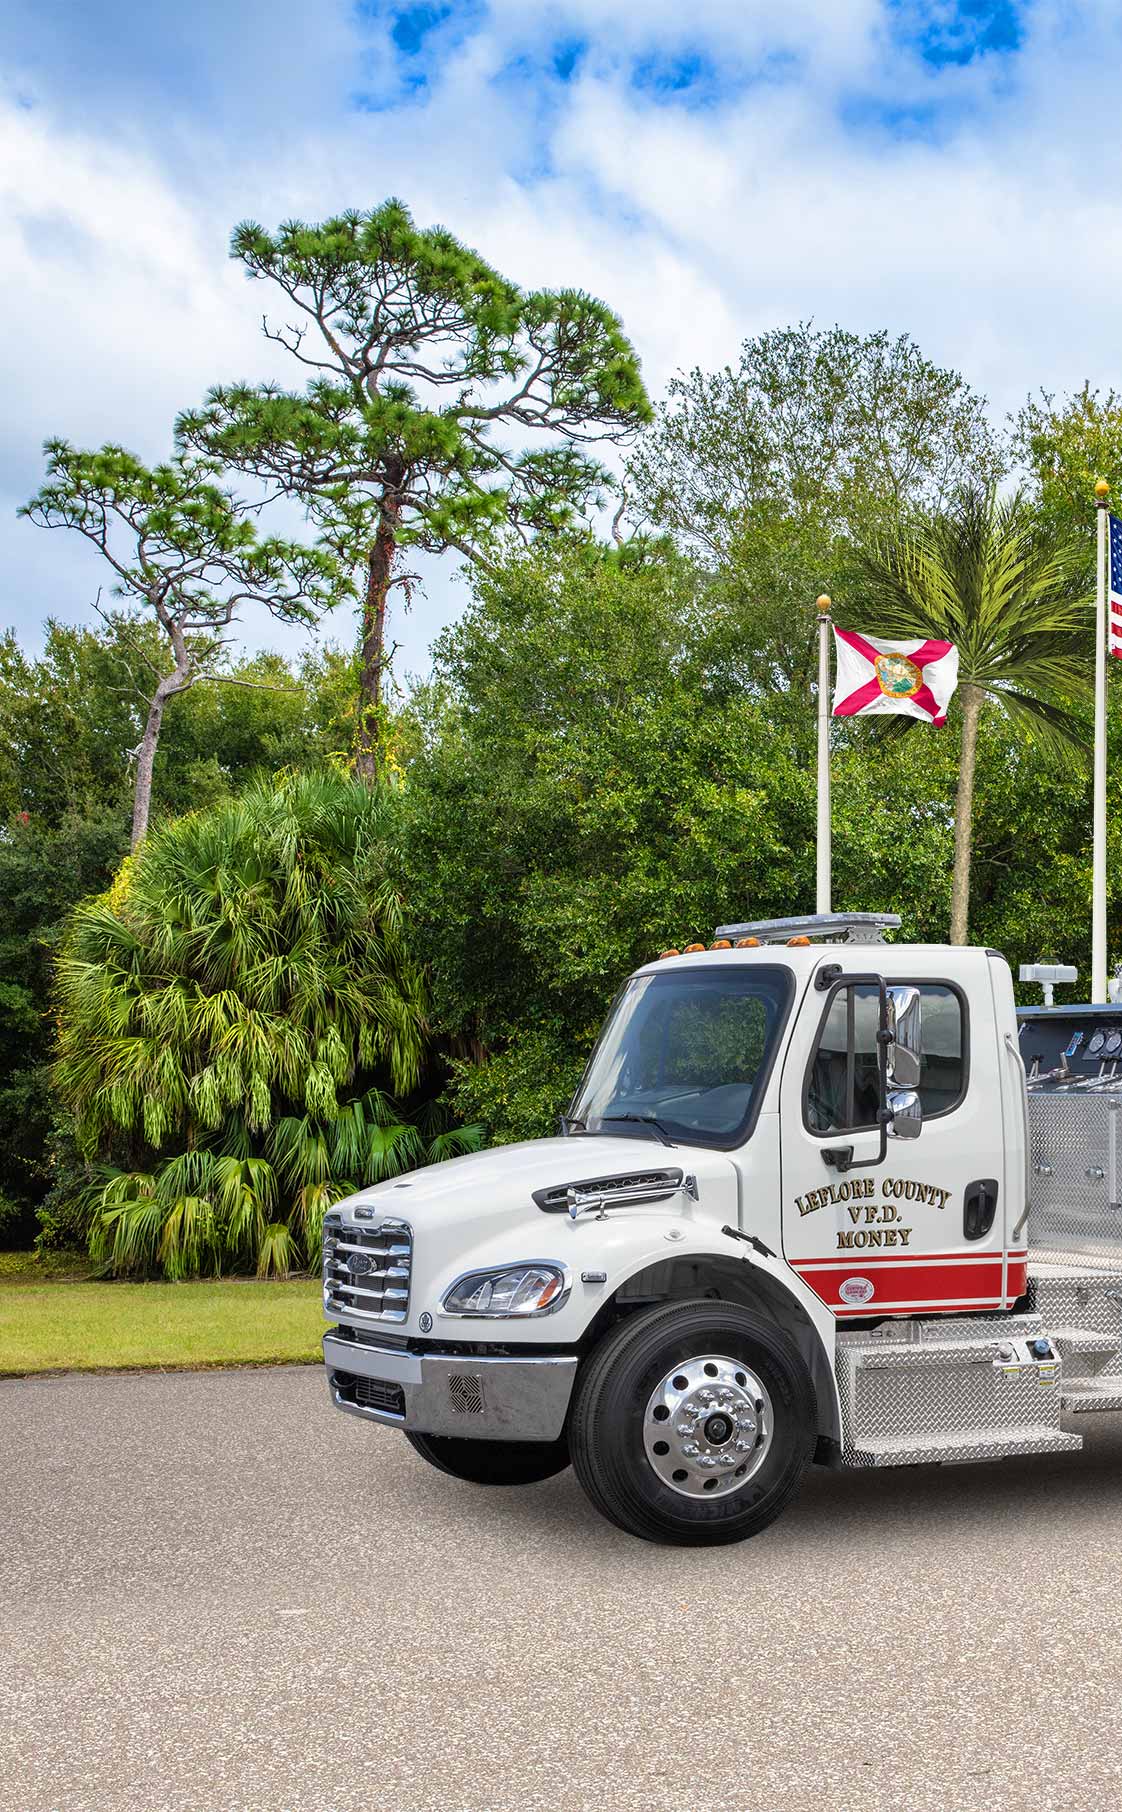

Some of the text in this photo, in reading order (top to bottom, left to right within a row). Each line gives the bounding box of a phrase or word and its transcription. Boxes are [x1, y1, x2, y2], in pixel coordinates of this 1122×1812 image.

[794, 1178, 952, 1217] LEFLORE COUNTY
[837, 1228, 912, 1249] MONEY
